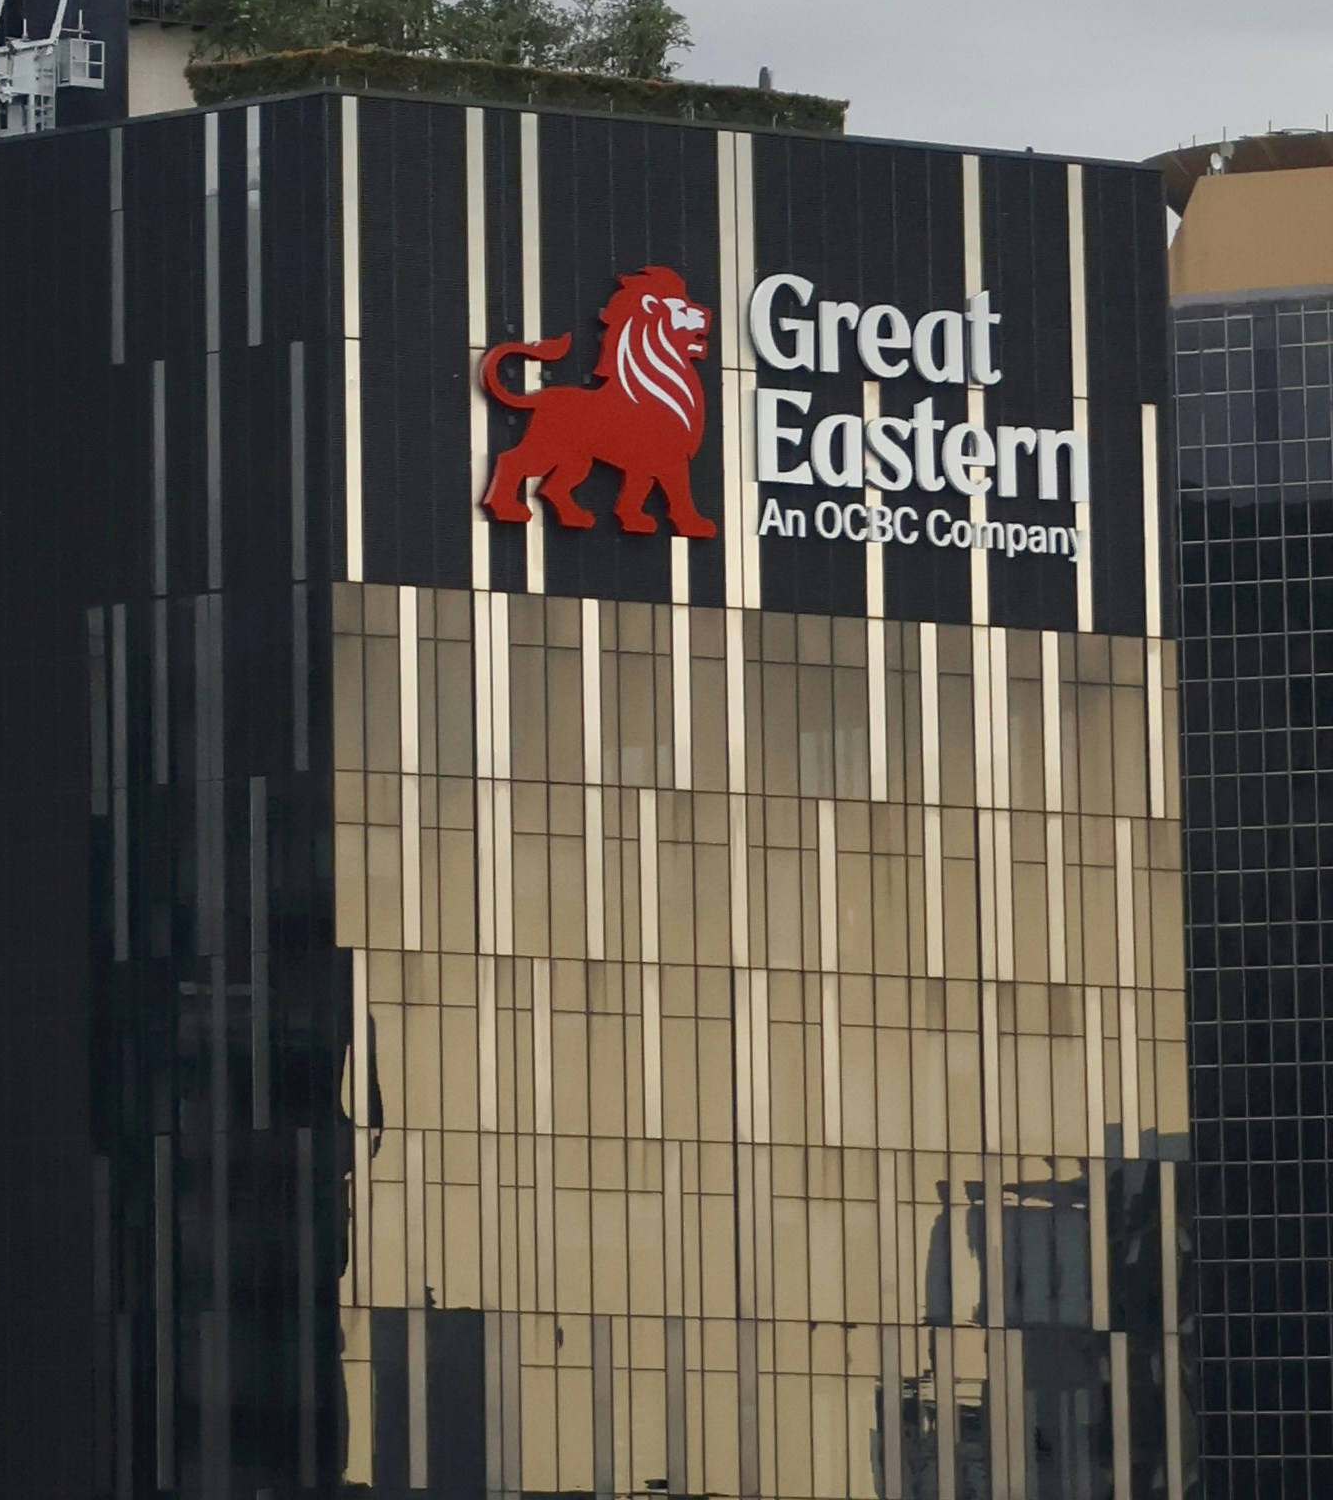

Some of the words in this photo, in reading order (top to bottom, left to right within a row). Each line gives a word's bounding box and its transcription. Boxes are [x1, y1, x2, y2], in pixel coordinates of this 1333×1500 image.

[749, 273, 1002, 385] Great
[757, 388, 1090, 502] Eastern
[758, 498, 807, 538] An
[815, 501, 920, 544] OCBC
[926, 509, 1085, 563] Company
